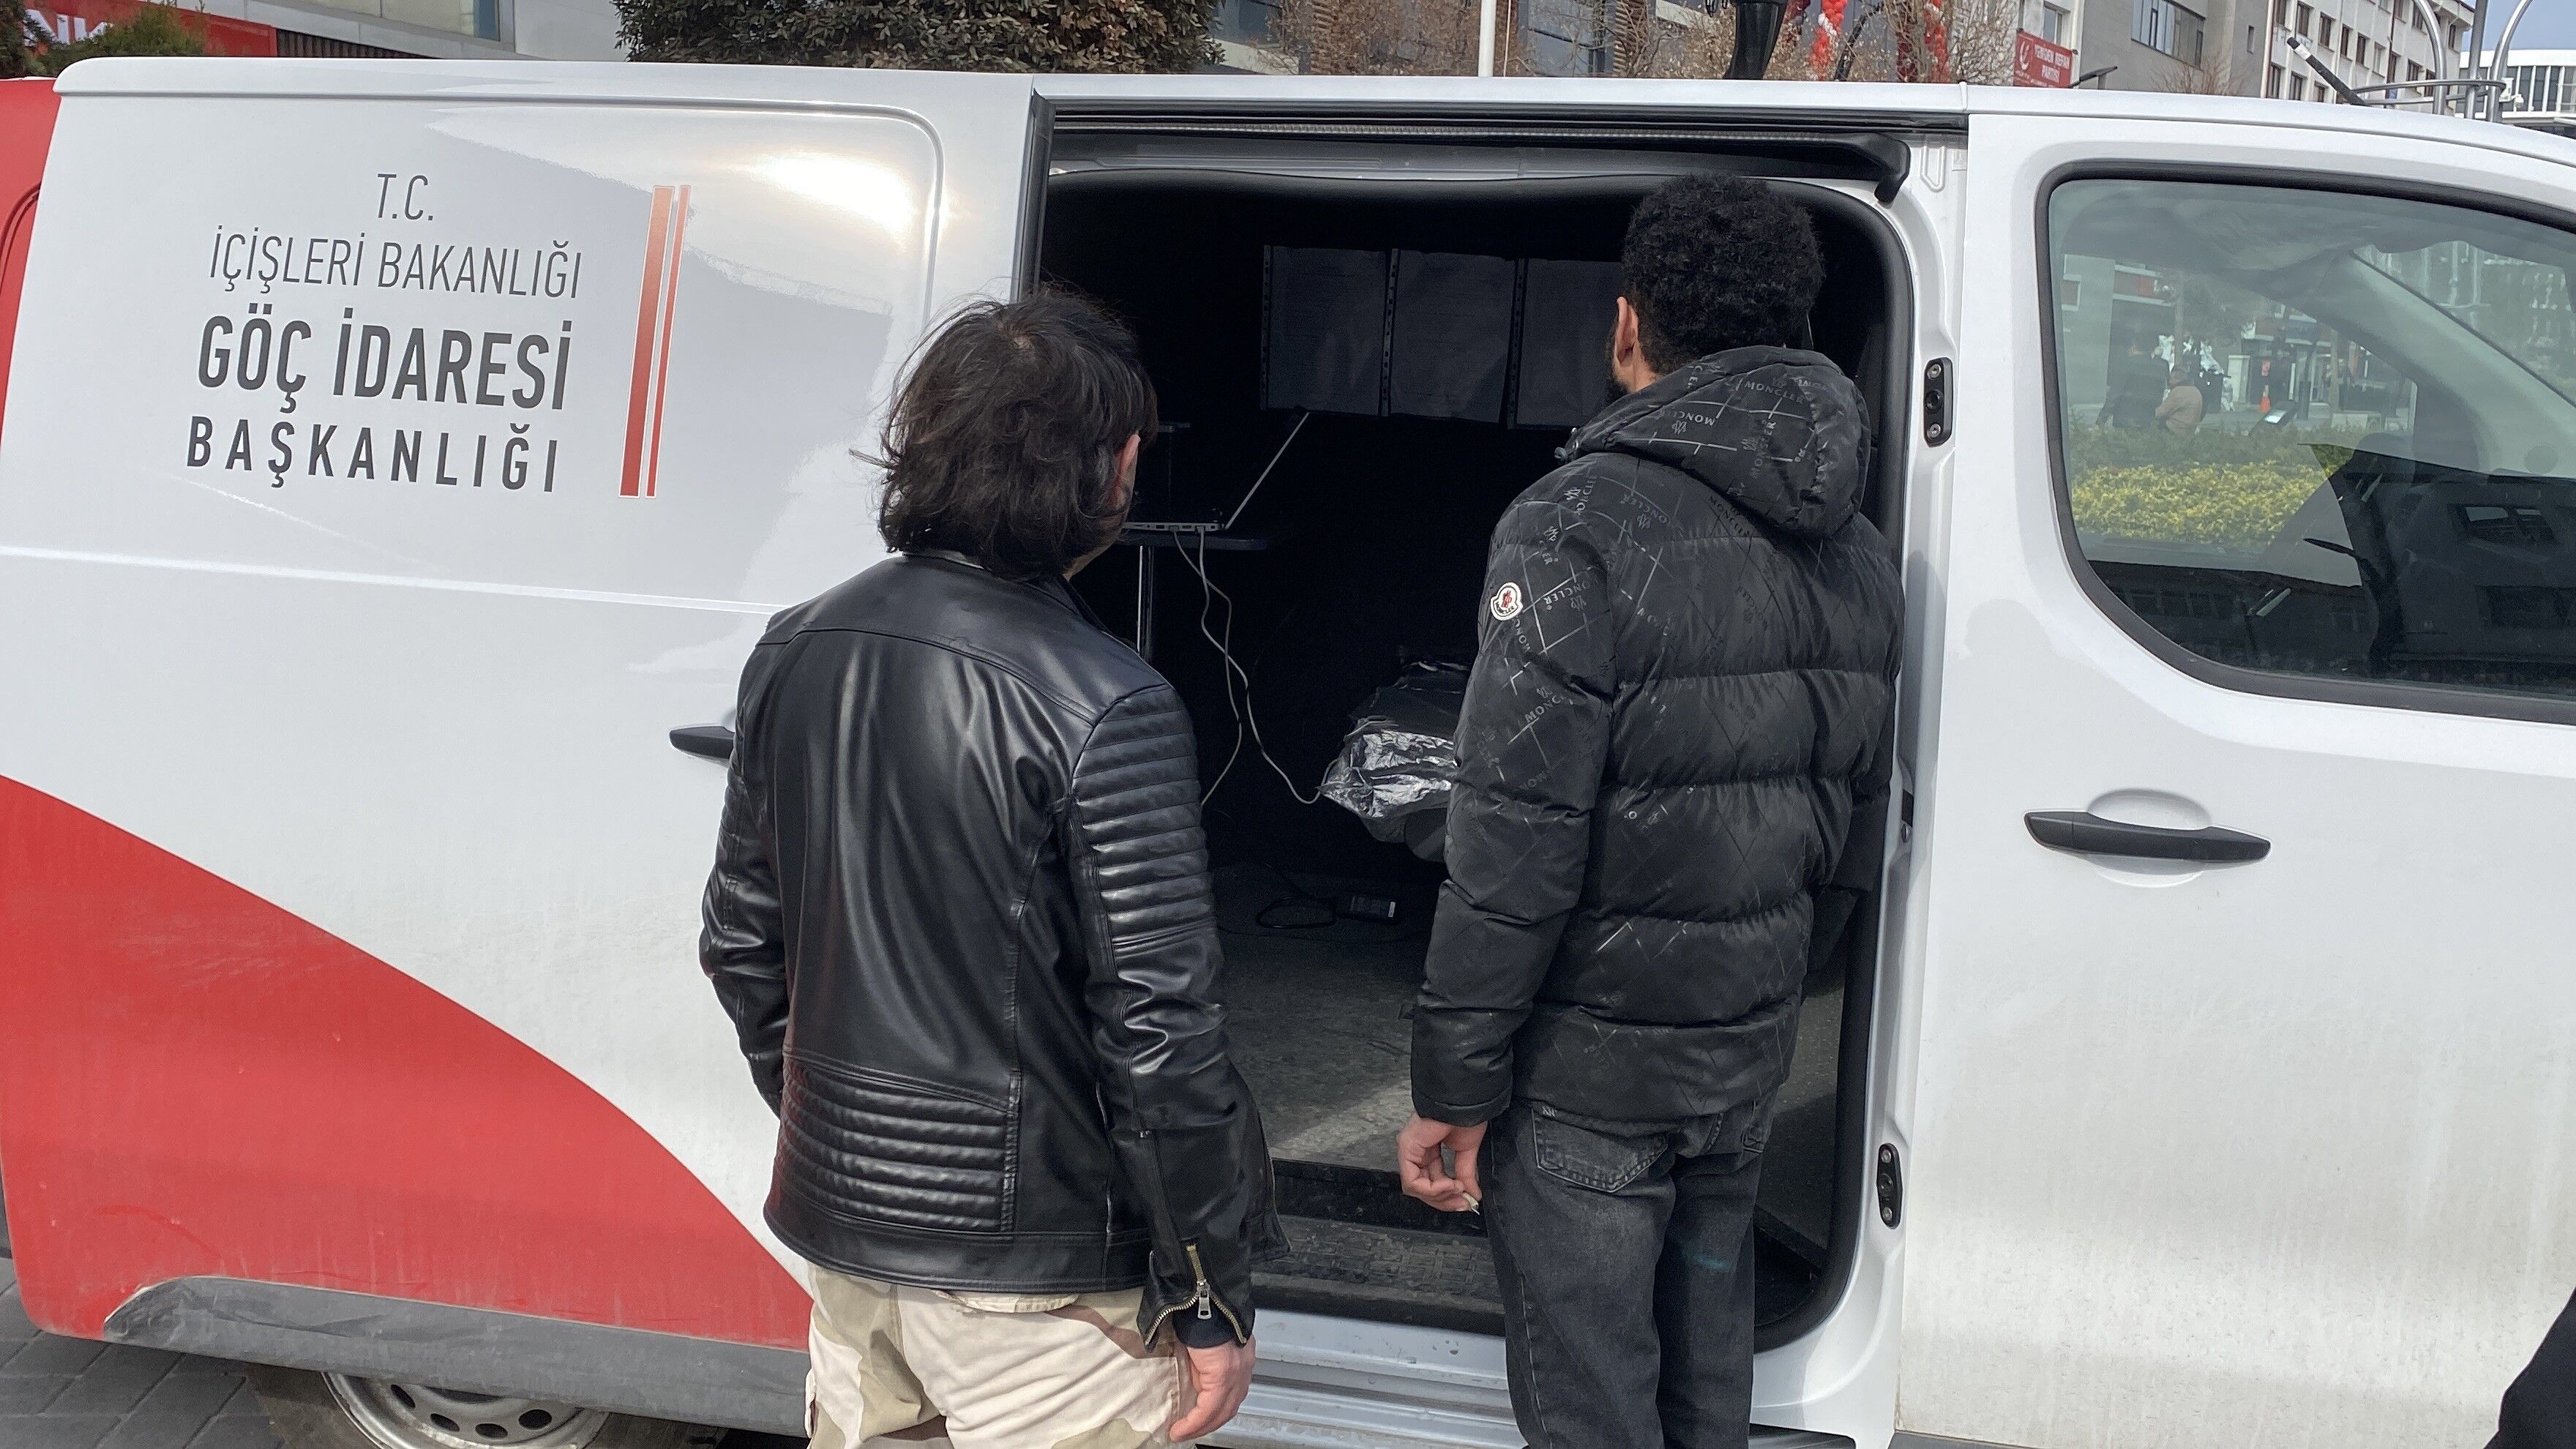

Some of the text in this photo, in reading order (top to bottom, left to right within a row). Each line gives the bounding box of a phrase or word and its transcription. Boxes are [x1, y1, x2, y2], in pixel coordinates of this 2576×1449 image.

[377, 173, 434, 222] T.C.
[209, 224, 583, 299] İÇİŞLERİ BAKANLIĞI
[198, 302, 573, 414] GÖÇ İDARESİ
[1745, 380, 1805, 405] MONCLER
[186, 415, 558, 493] BAŞKANLIĞI
